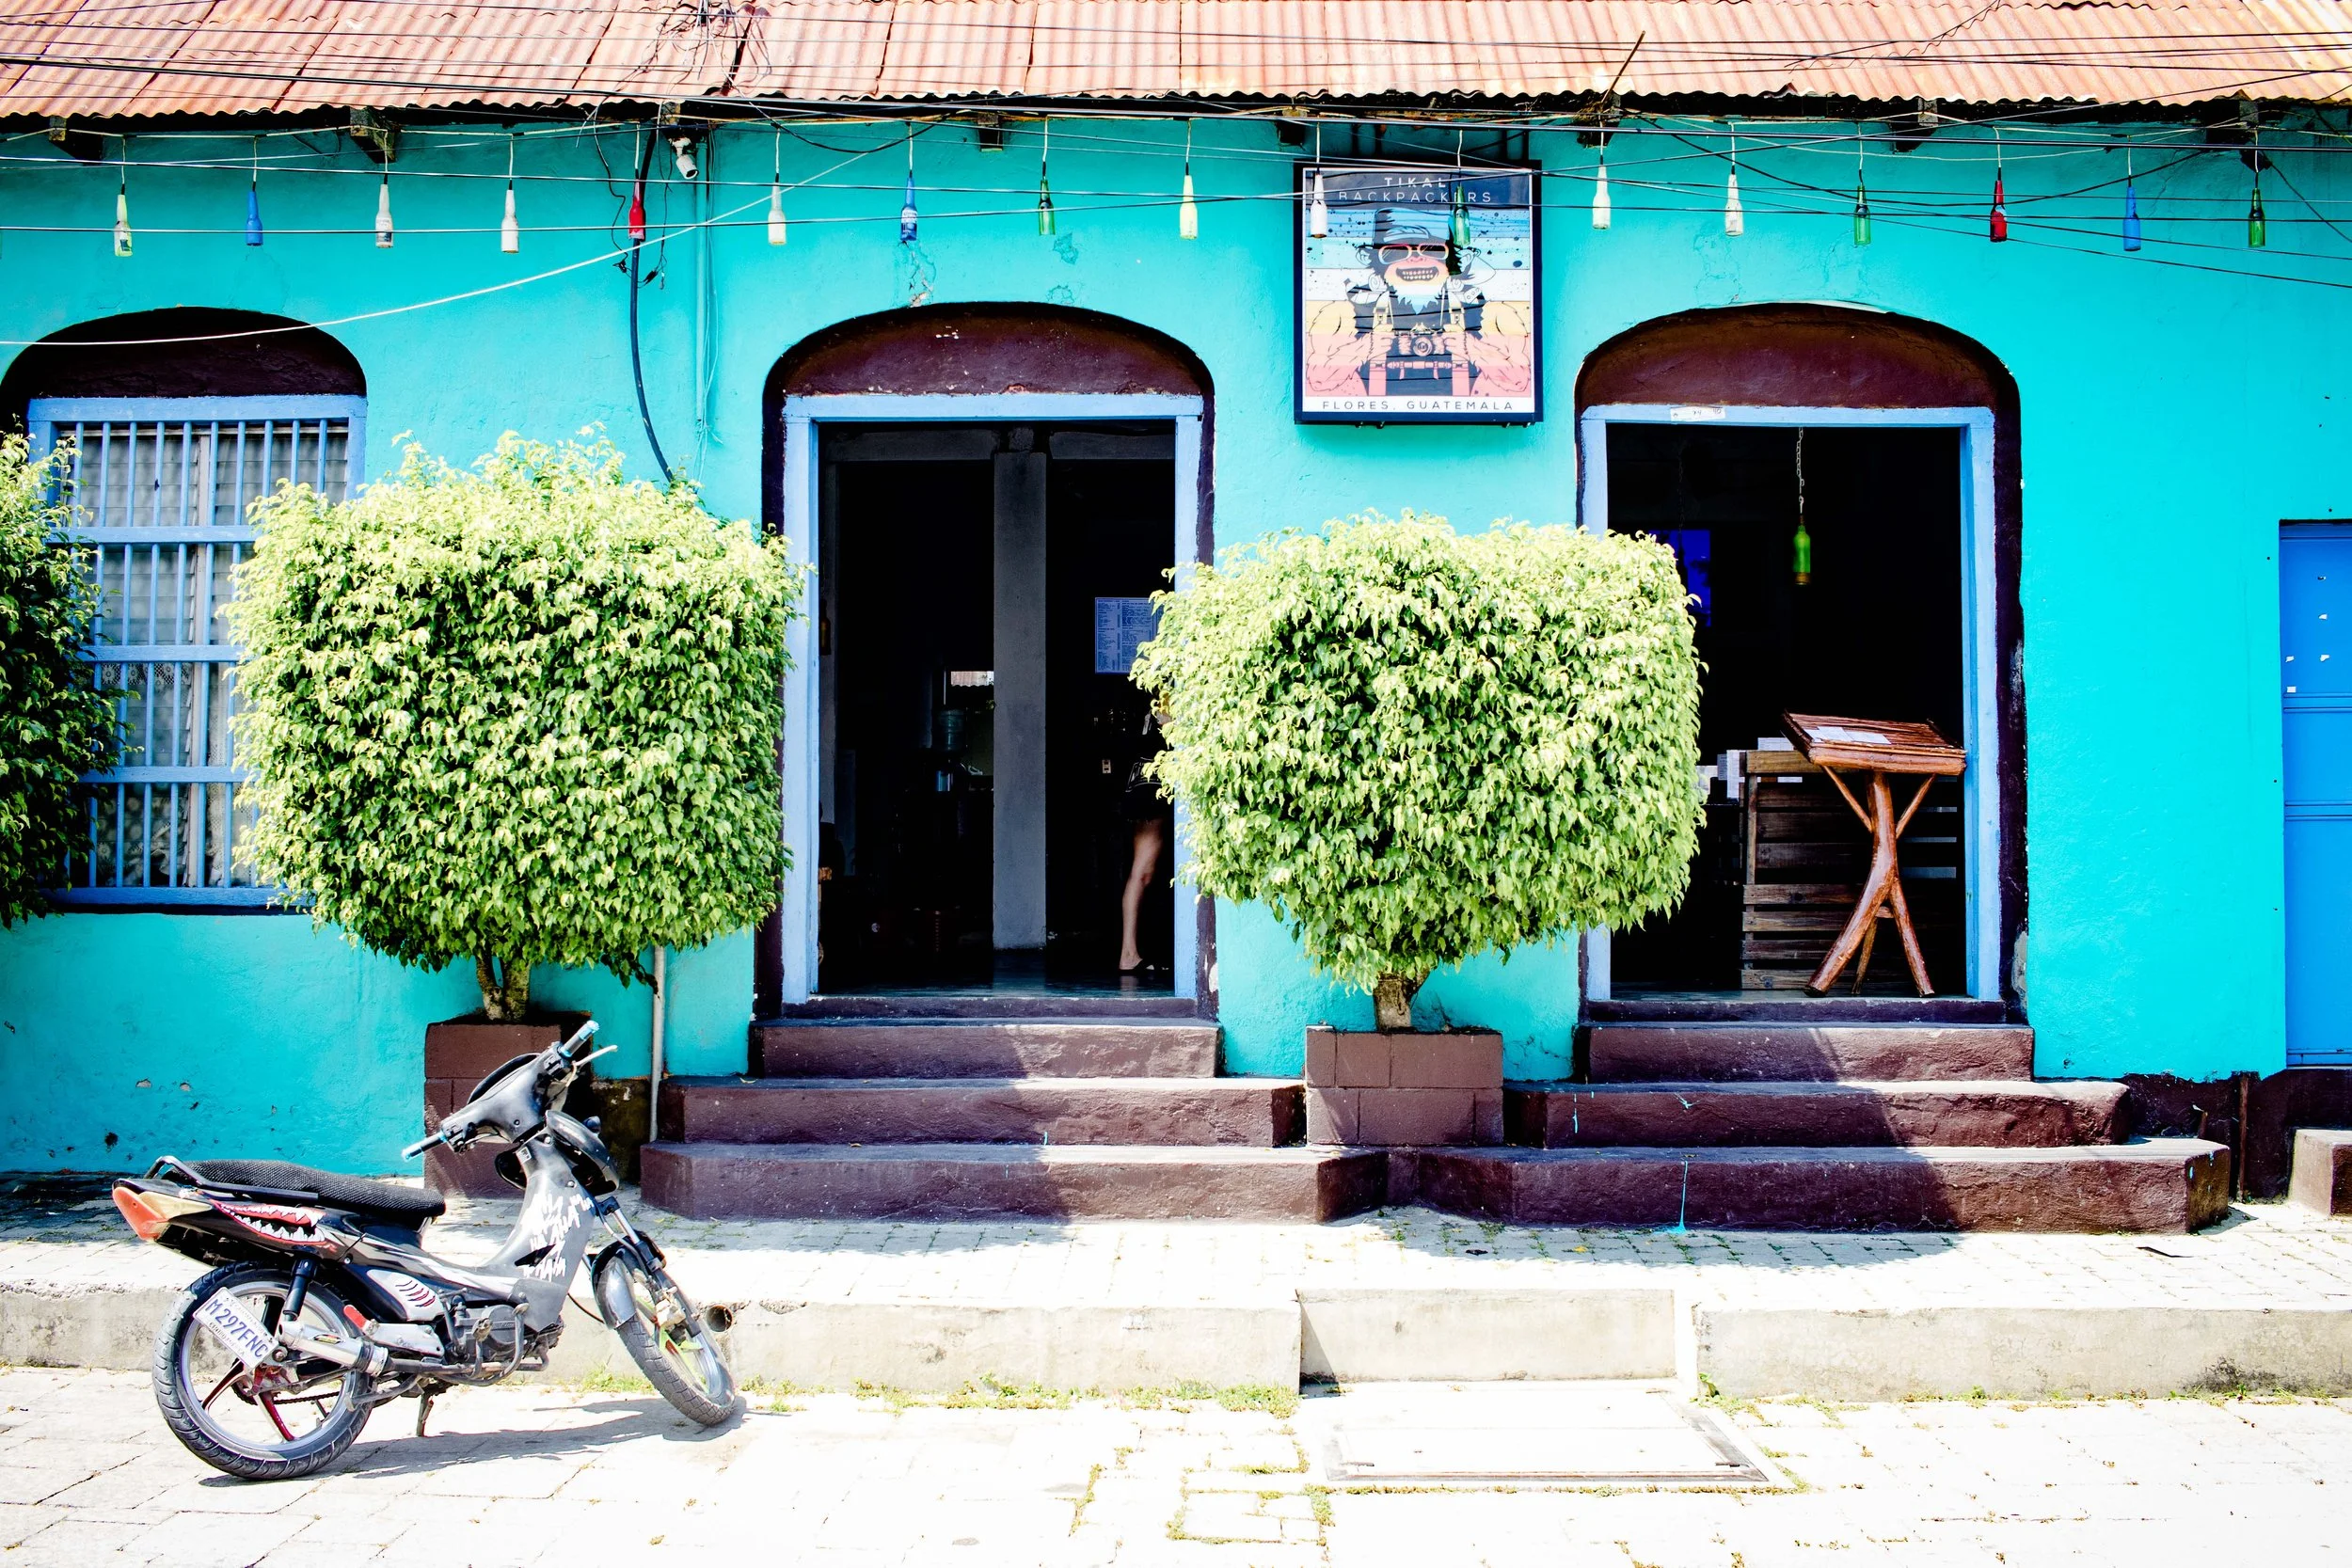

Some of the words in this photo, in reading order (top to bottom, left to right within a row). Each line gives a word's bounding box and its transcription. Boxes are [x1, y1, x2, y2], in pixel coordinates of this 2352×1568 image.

[1384, 177, 1446, 188] TIKAL
[1322, 401, 1395, 410] FLORES,
[1406, 401, 1513, 410] GUATEMALA
